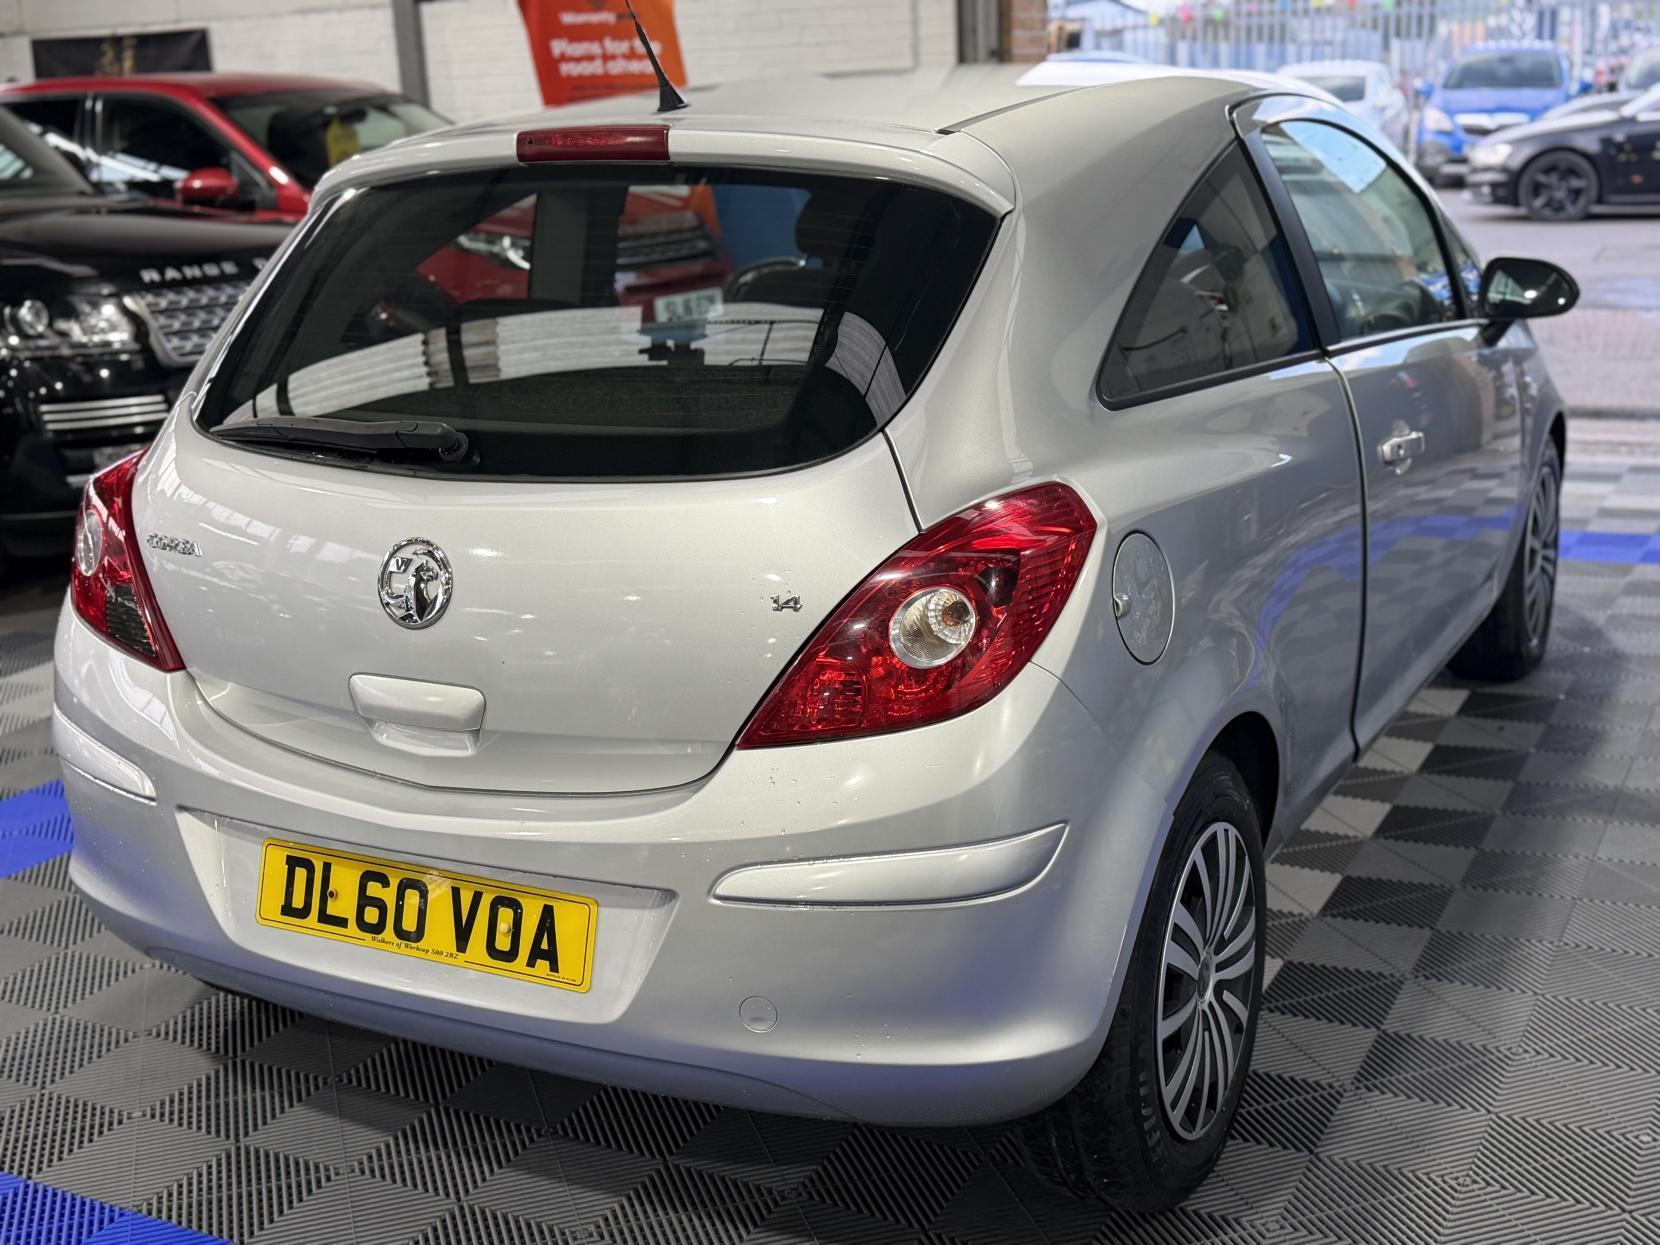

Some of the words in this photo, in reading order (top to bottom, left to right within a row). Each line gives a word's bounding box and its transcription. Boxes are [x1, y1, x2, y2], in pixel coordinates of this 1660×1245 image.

[549, 37, 601, 58] Plans
[604, 36, 630, 56] for
[559, 56, 604, 77] road
[139, 260, 239, 284] RANGE
[279, 853, 429, 944] DL60
[450, 885, 561, 974] VOA
[371, 935, 395, 946] Walkers
